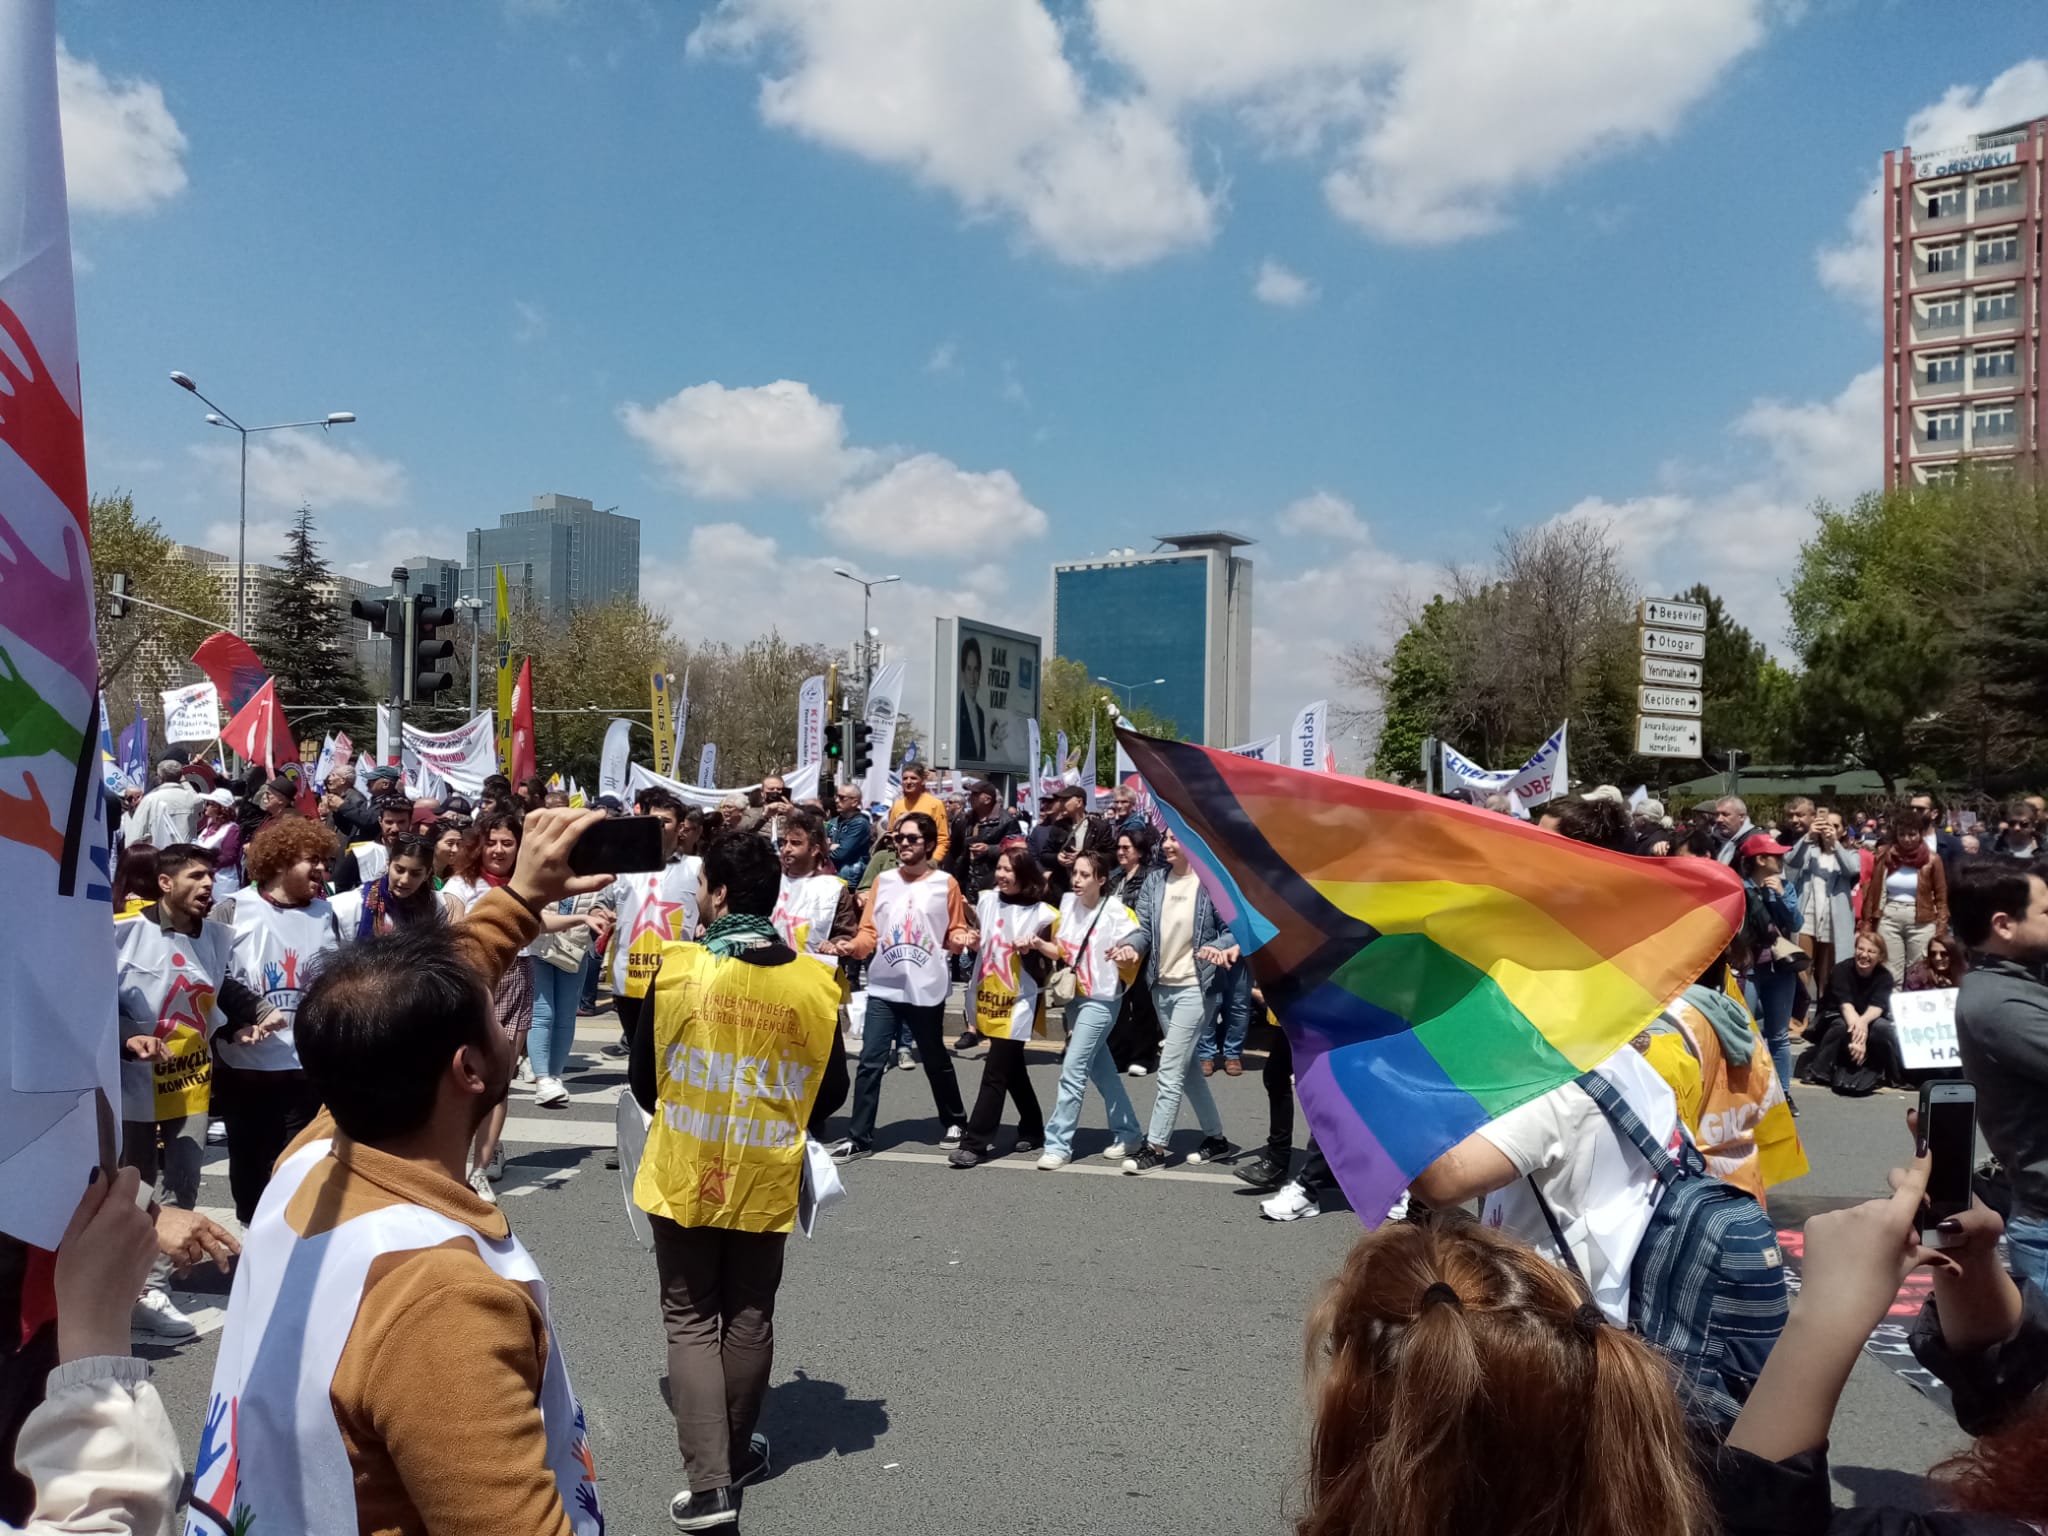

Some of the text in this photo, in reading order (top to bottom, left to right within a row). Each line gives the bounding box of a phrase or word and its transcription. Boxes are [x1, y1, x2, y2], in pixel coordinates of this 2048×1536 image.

[1660, 606, 1702, 621] Beşevler
[1659, 635, 1695, 652] Otogar
[1648, 664, 1687, 679] Yenimahalle
[1644, 692, 1686, 706] Keçiören
[884, 947, 929, 966] UMUT-SEN
[978, 990, 1016, 1008] GEÇLİK
[666, 1042, 813, 1108] GENÇLİK
[664, 1099, 798, 1148] KOMİTELERİ
